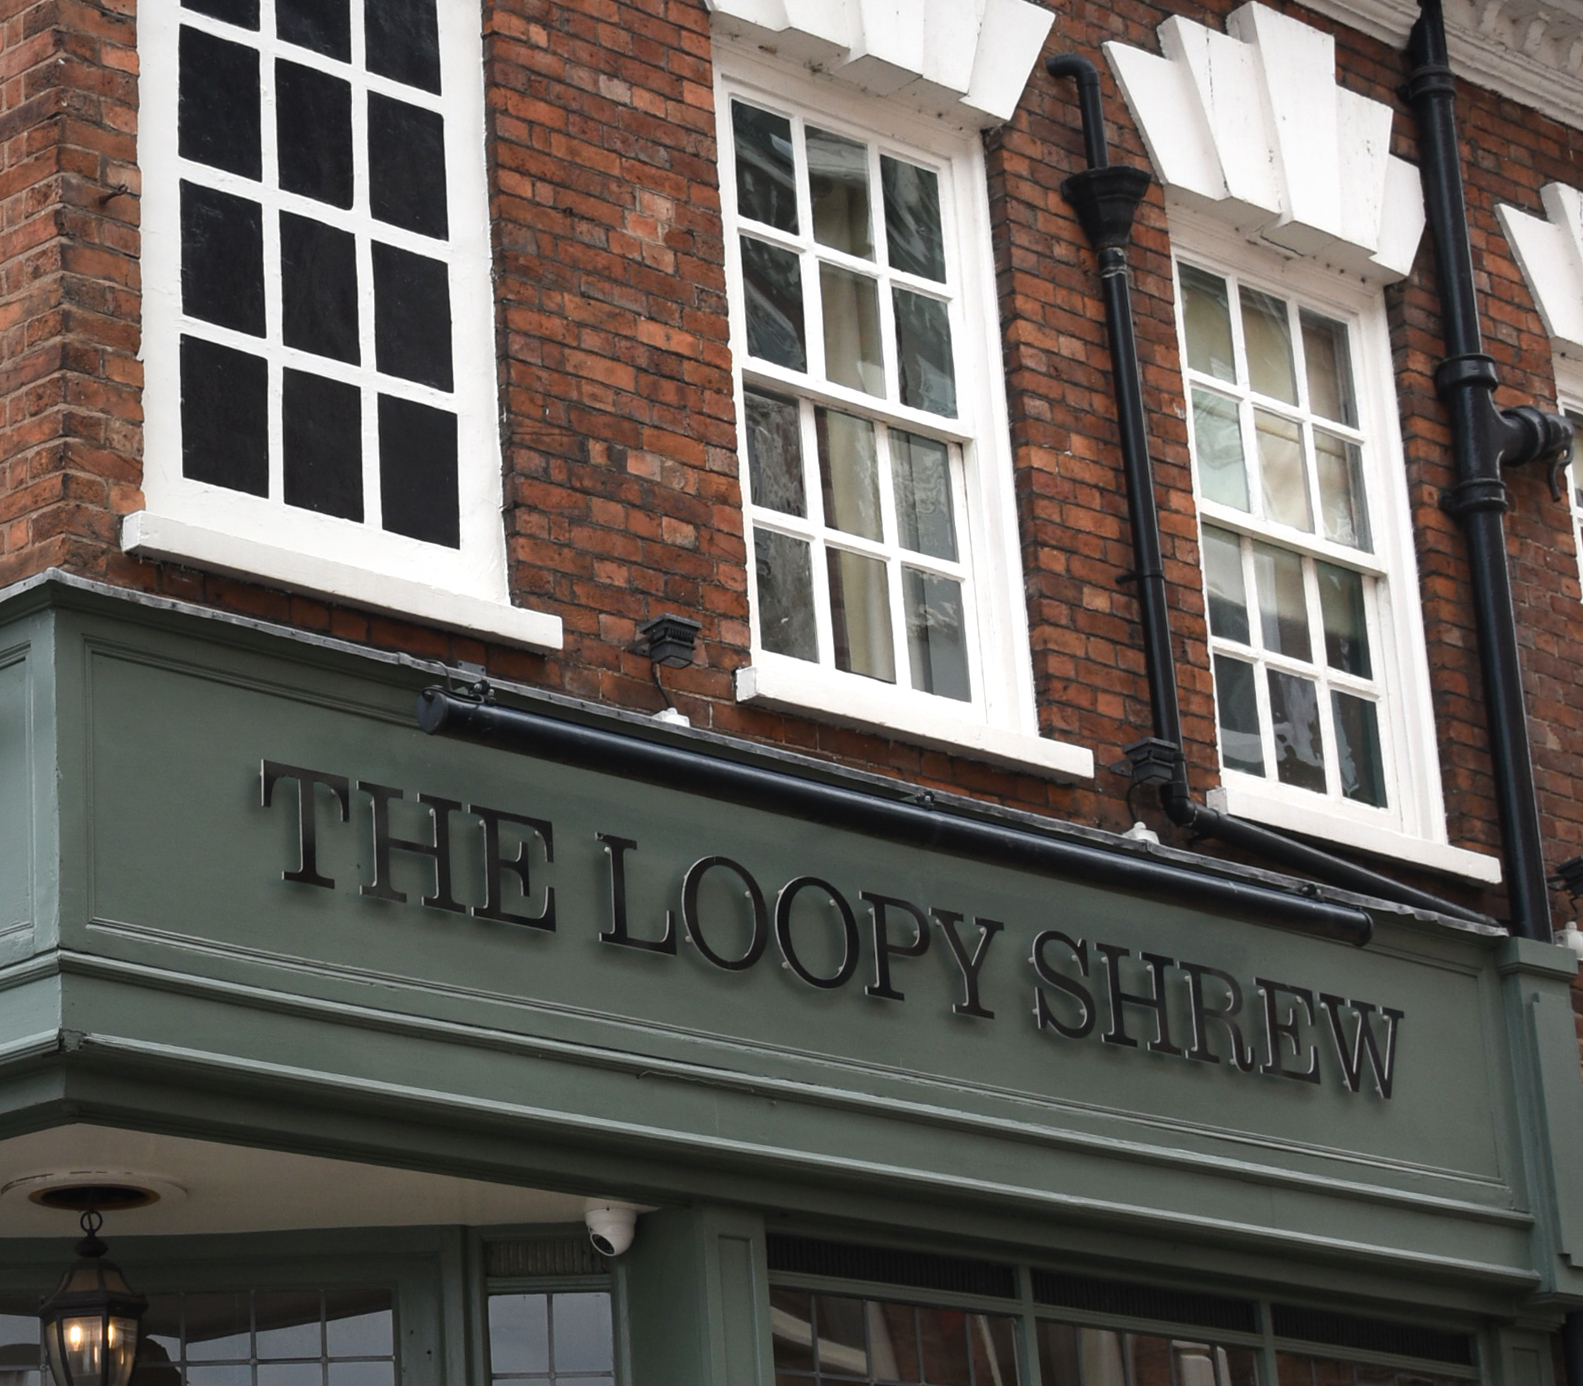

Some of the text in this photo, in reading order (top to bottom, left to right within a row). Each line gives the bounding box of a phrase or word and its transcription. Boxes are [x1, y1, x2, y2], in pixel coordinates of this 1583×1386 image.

[260, 759, 1405, 1101] THE LOOPY SHREW
